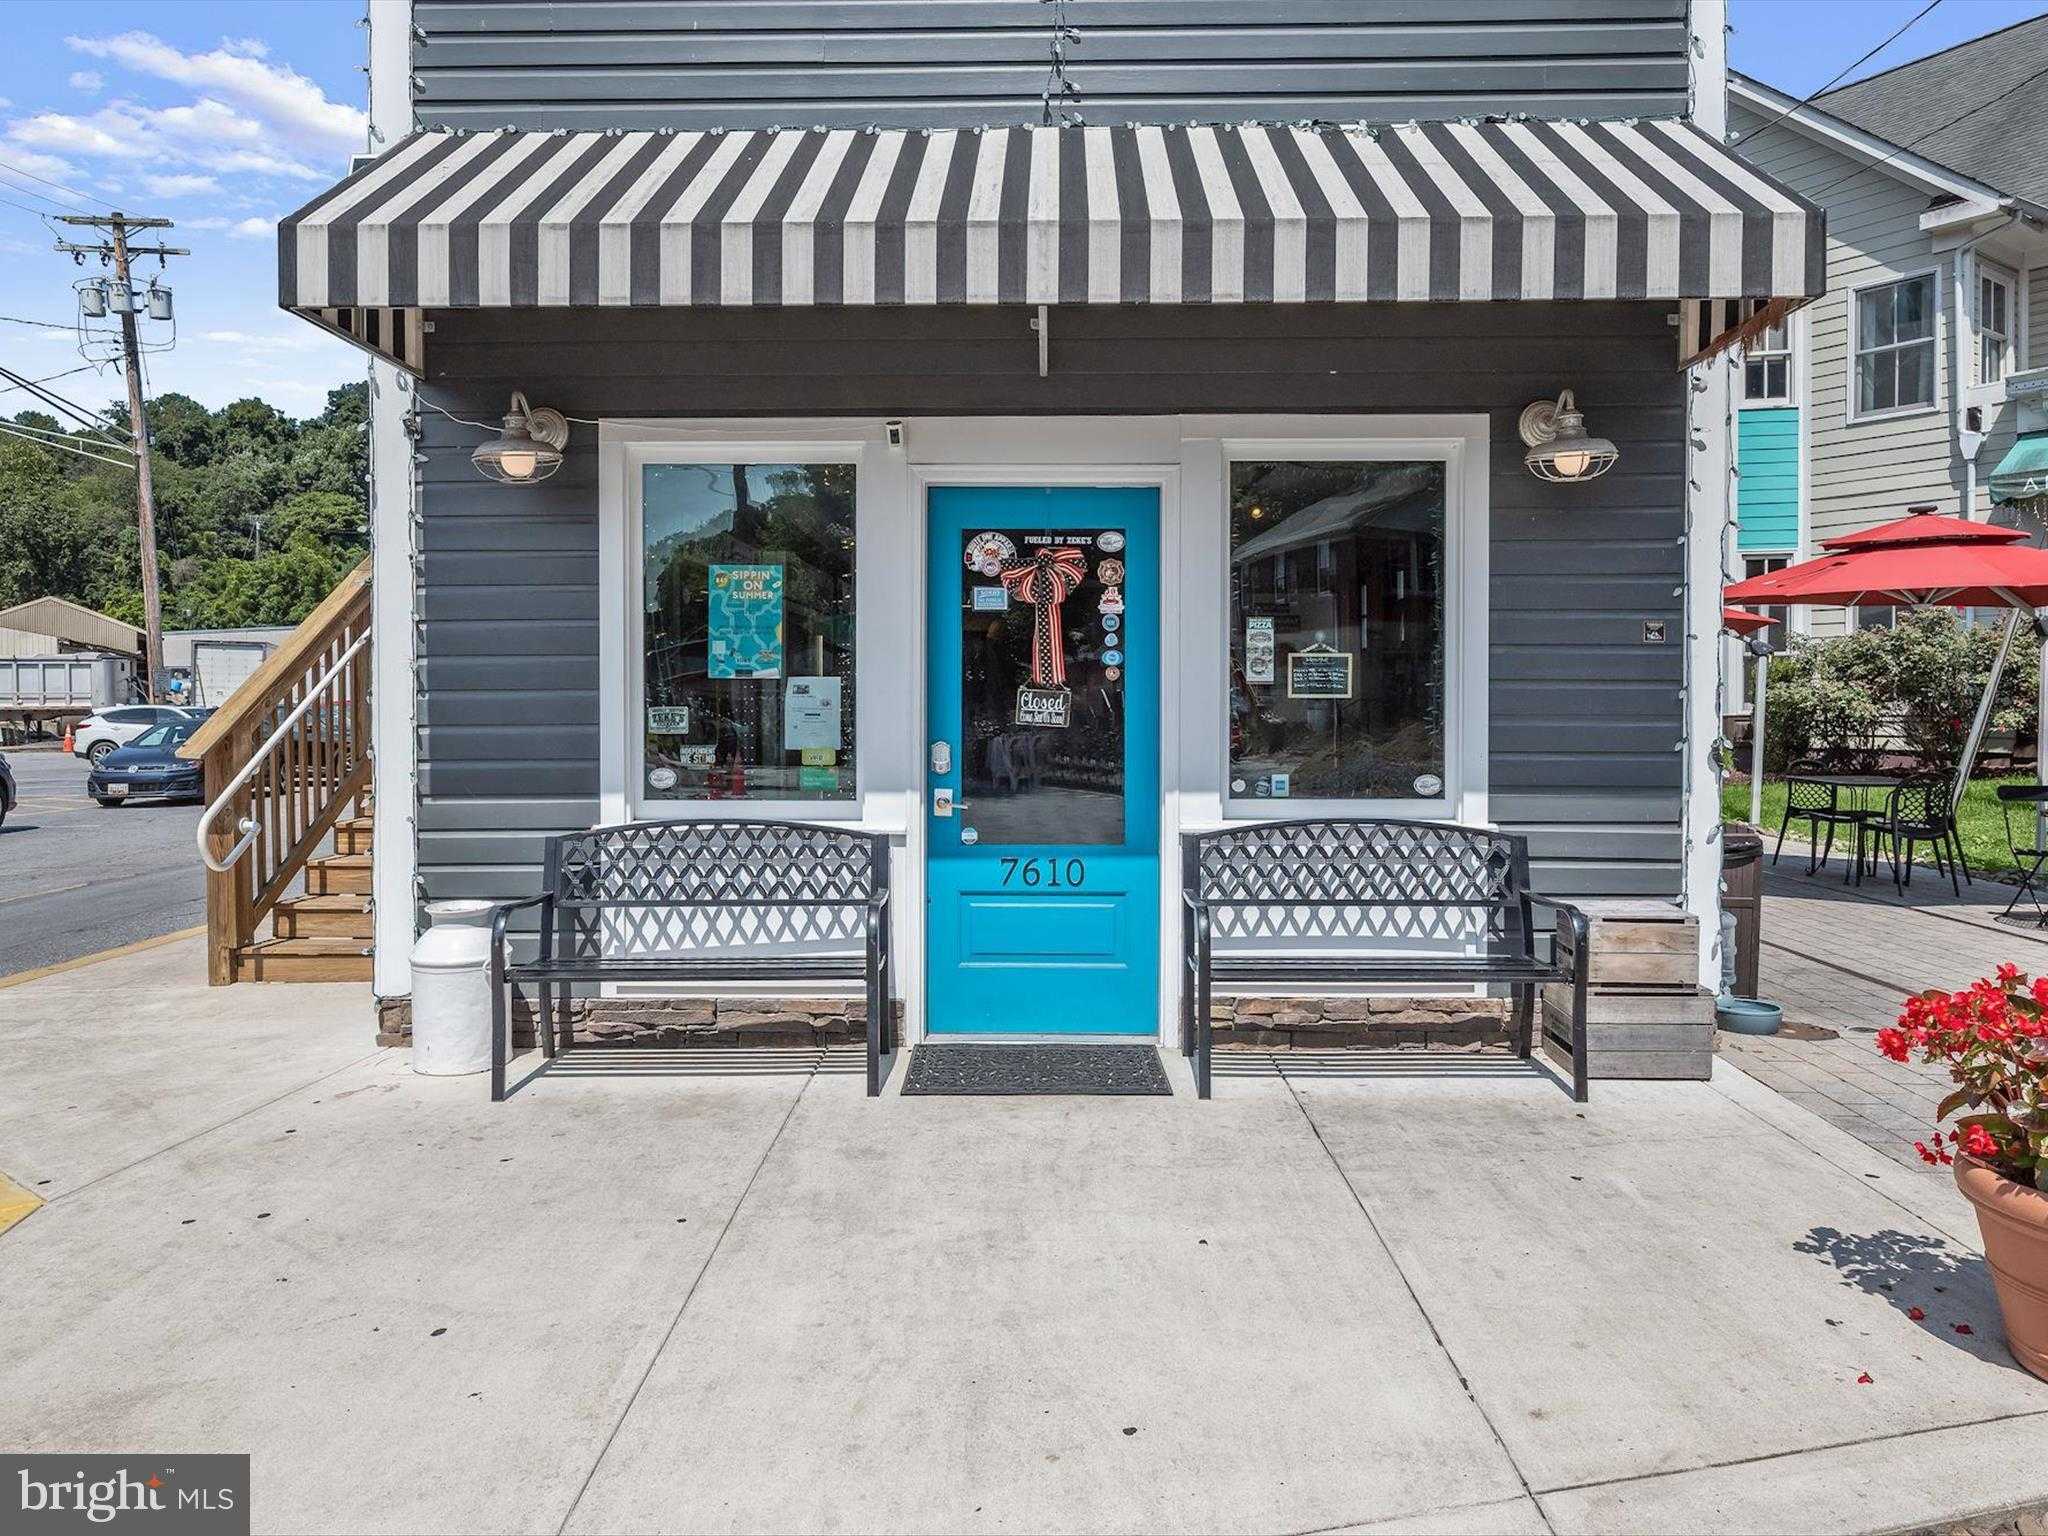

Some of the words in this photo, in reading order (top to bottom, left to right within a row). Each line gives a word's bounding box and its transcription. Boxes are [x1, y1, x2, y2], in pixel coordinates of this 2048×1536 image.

[1024, 536, 1052, 544] FUELED
[1054, 536, 1064, 544] BY
[1066, 536, 1092, 544] ZEKE'S
[743, 580, 763, 590] ON
[732, 590, 774, 600] SUMMER
[1249, 621, 1272, 629] PIZZA
[1021, 691, 1066, 710] Closed
[652, 712, 685, 723] ZEKE'S
[680, 754, 692, 764] WE
[1000, 857, 1085, 888] 7610
